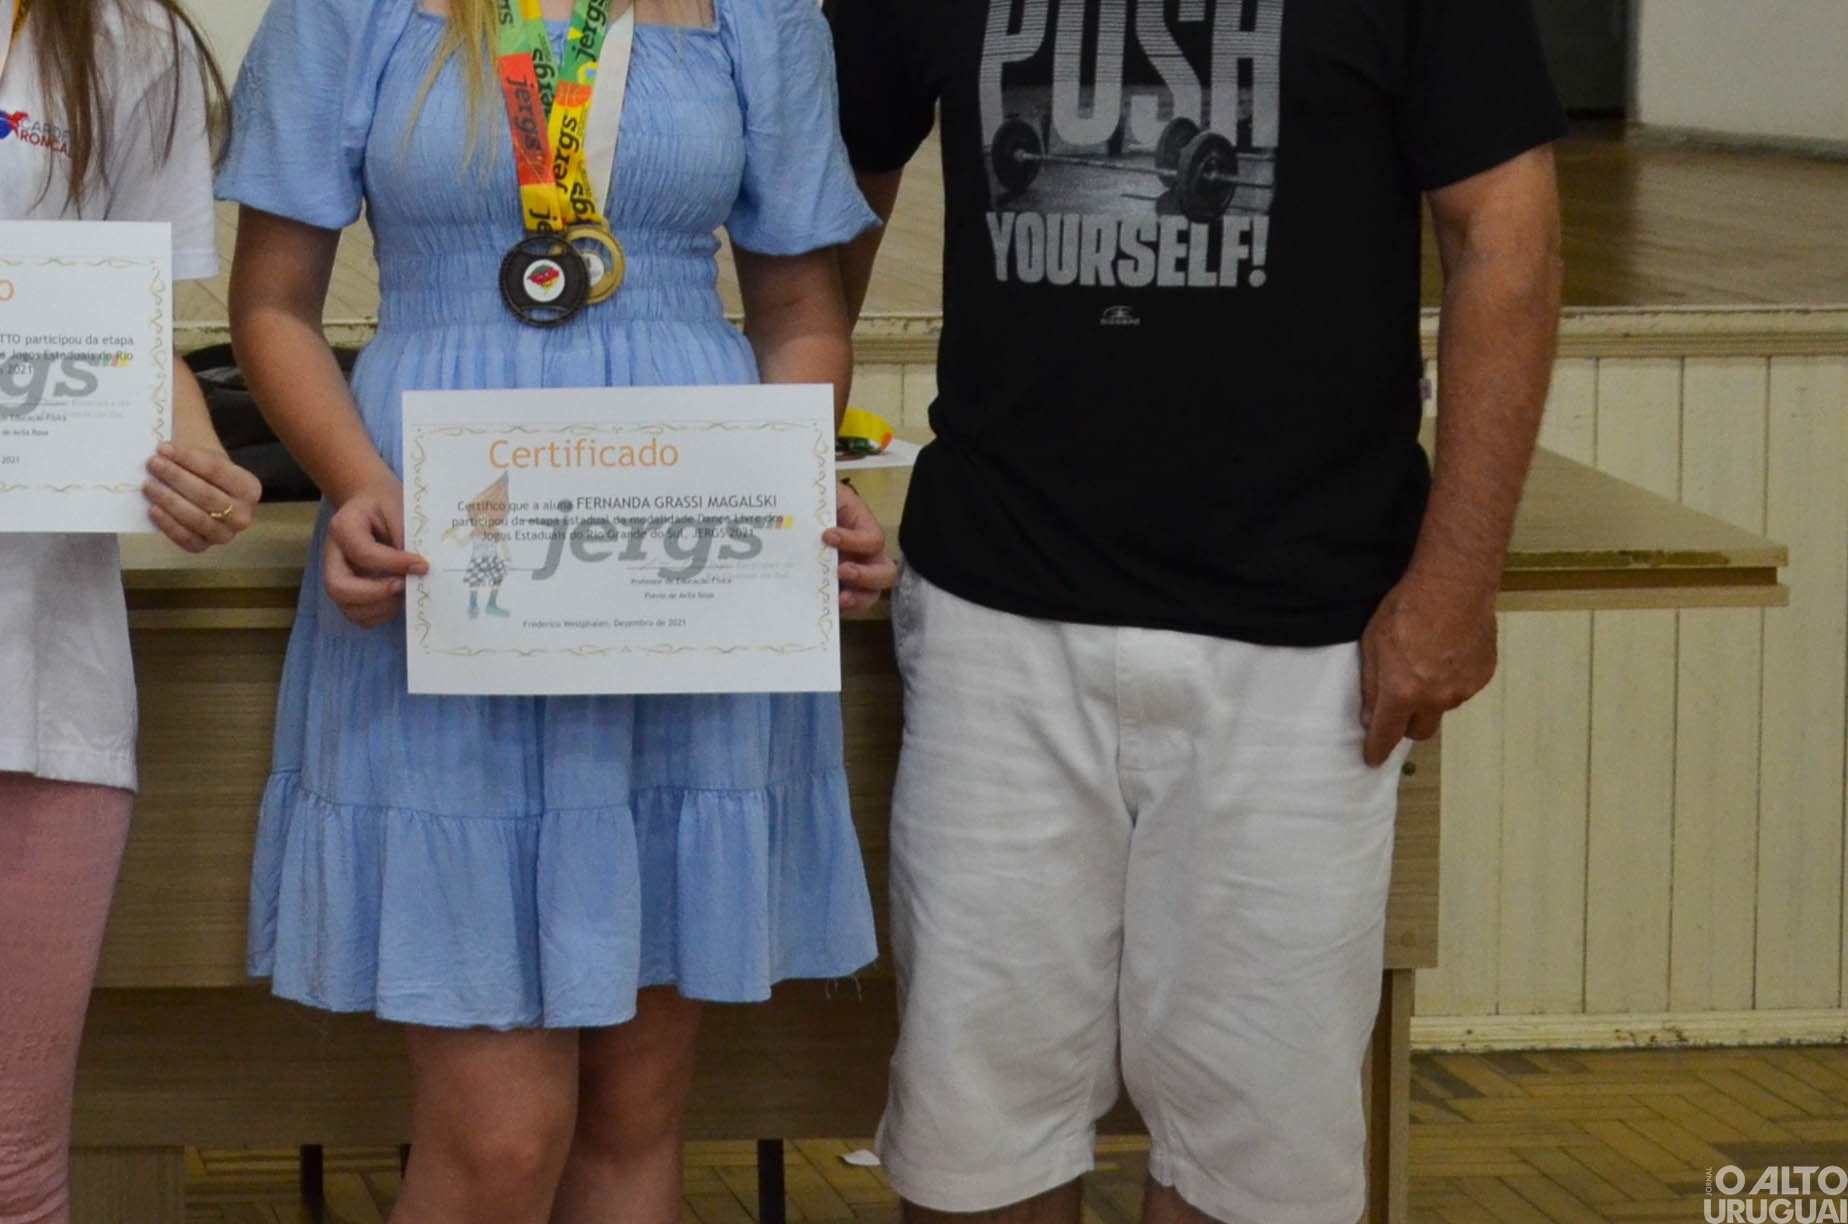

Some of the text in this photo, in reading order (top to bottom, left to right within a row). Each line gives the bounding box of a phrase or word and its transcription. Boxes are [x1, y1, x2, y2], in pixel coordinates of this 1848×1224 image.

[506, 75, 542, 151] jergs
[552, 114, 579, 194] jergs
[985, 211, 1270, 288] YOURSELF!
[24, 333, 82, 346] participou
[85, 334, 99, 346] da
[101, 335, 134, 347] etapa
[488, 437, 680, 470] Certificado
[510, 501, 530, 514] que
[532, 502, 540, 511] a
[576, 496, 651, 510] FERNANDA
[654, 495, 703, 509] GRASSI
[707, 494, 778, 508] MAGALSKI
[510, 515, 525, 527] da
[532, 499, 764, 582] jergs
